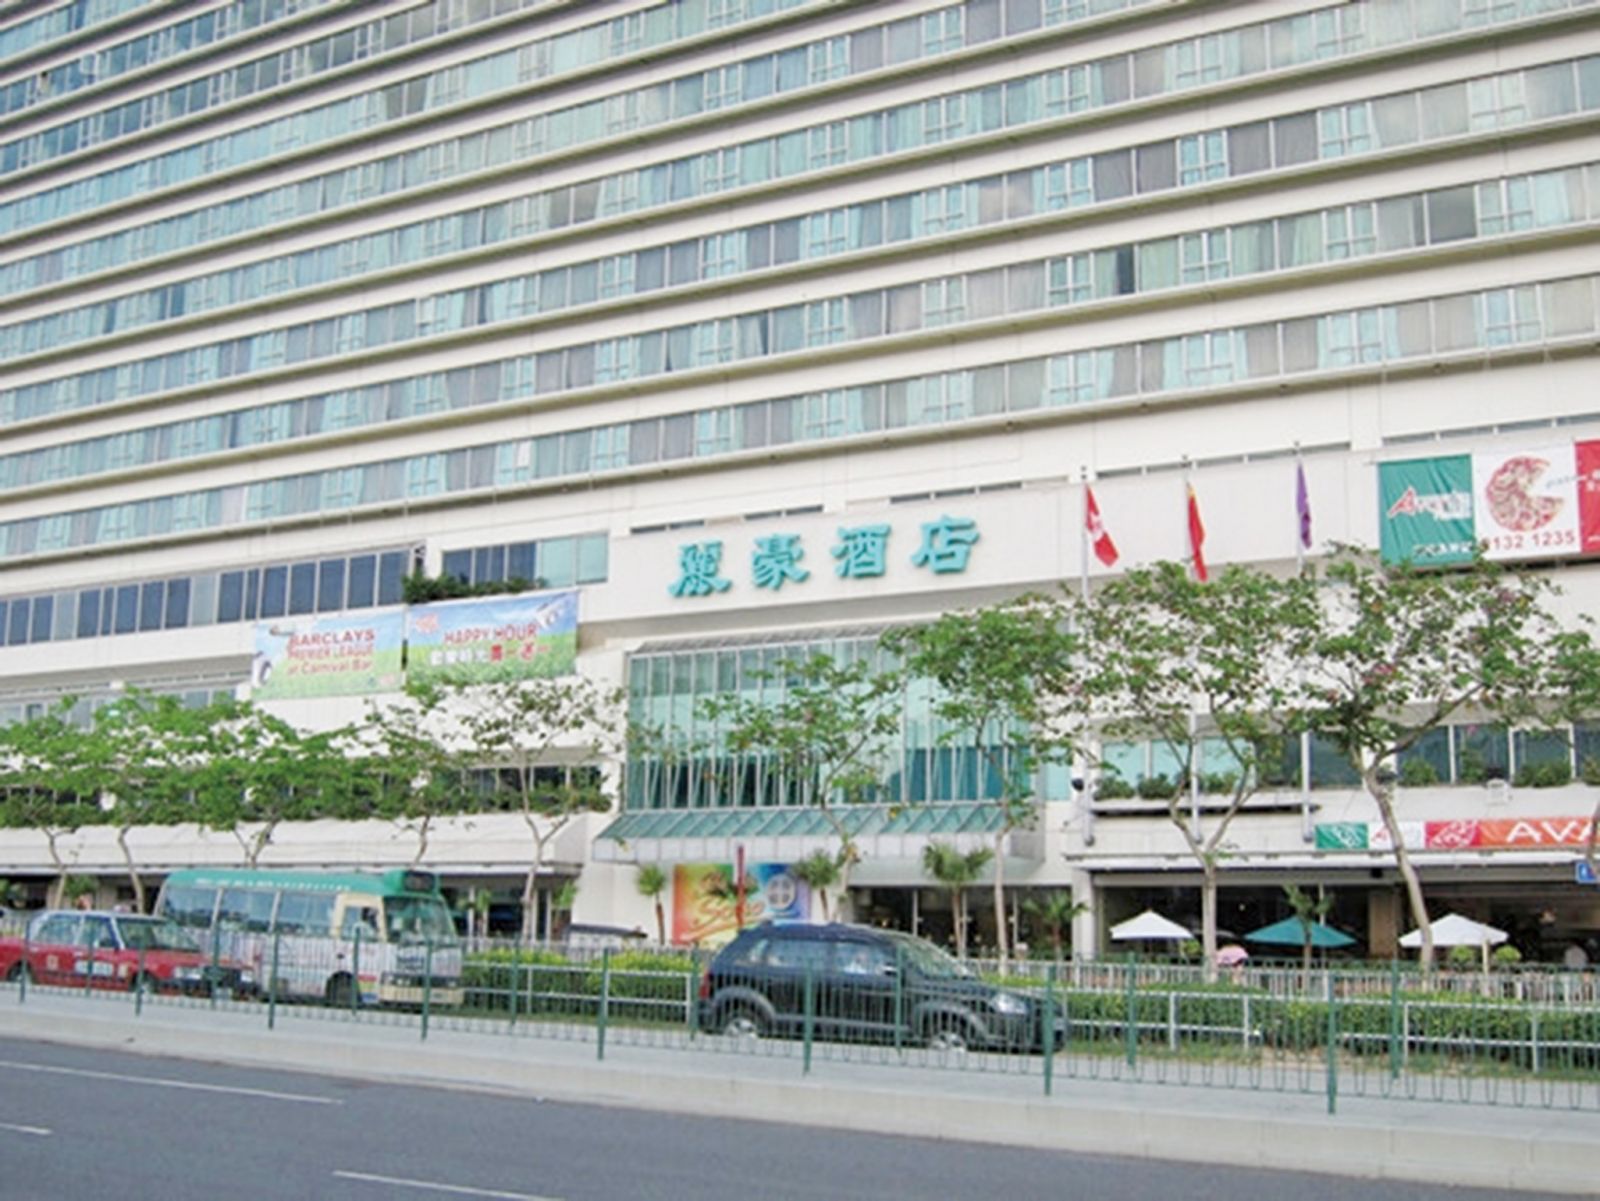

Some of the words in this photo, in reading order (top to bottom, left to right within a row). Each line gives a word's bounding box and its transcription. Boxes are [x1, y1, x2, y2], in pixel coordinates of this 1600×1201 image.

[1482, 535, 1524, 551] 132
[1533, 531, 1575, 546] 1235
[288, 629, 375, 645] BARCLAYS
[444, 628, 492, 644] HAPPY
[494, 623, 537, 640] HOUR
